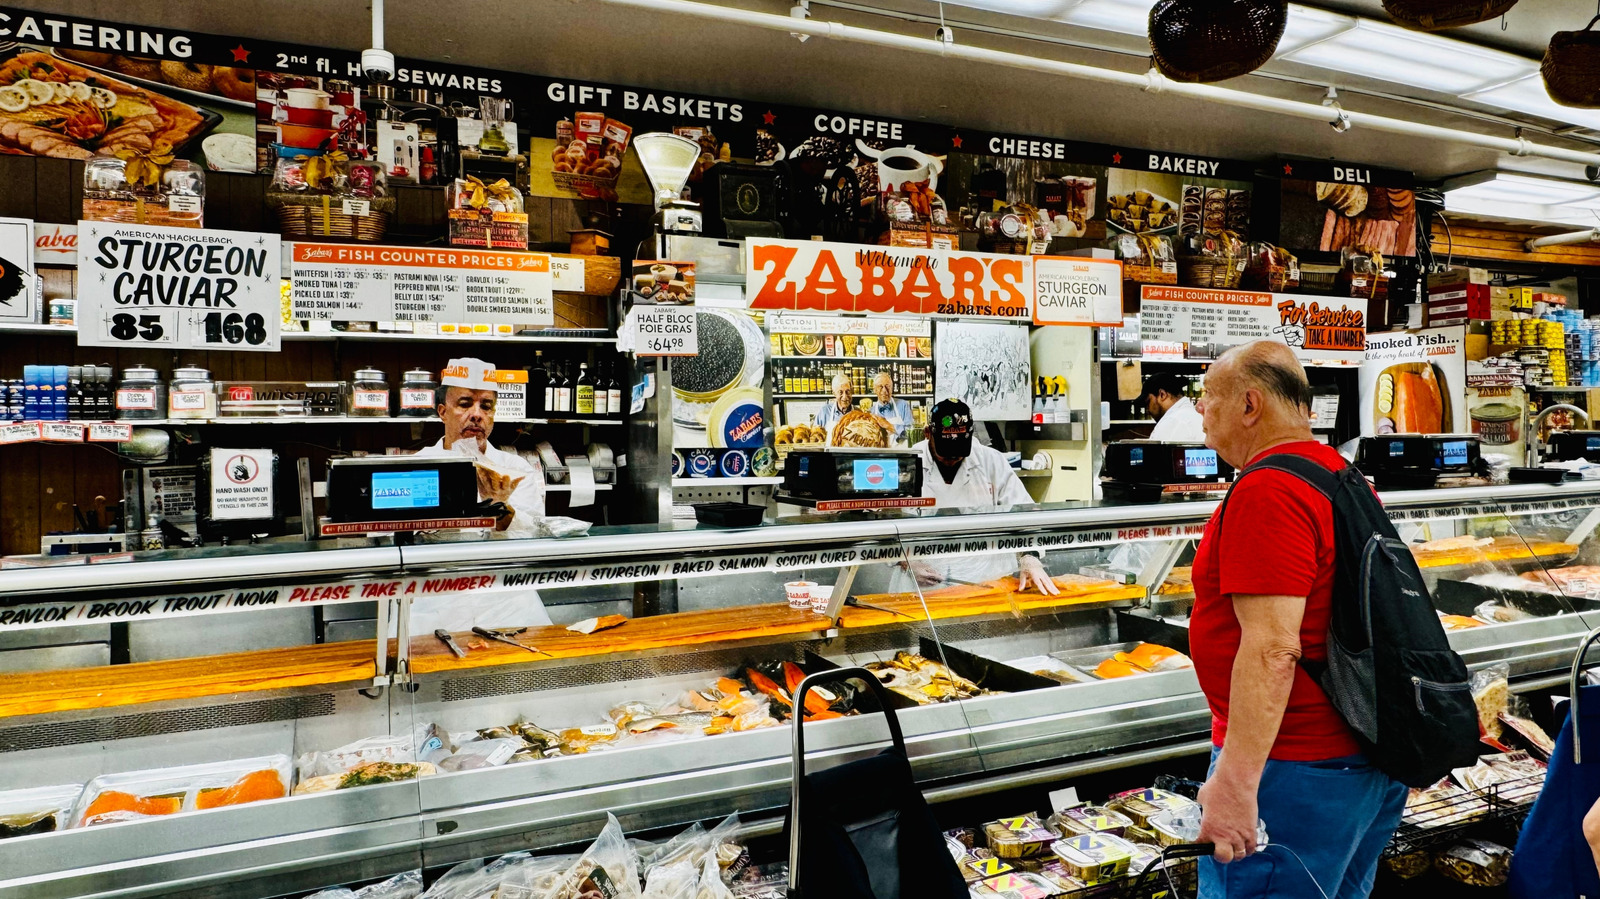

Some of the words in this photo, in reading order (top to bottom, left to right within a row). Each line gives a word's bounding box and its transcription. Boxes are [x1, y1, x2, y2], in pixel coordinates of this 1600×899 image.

[276, 53, 307, 70] 2nd
[316, 57, 337, 75] fl.
[347, 61, 503, 94] HSEWARES
[547, 82, 612, 107] GIFT
[623, 90, 743, 122] BASKETS
[814, 114, 903, 141] COFFEE
[989, 137, 1065, 159] CHEESE
[1148, 154, 1220, 176] BAKERY
[1333, 166, 1371, 183] DELI
[114, 229, 166, 241] AMERICAN
[170, 234, 233, 244] HACKLEBACK
[95, 236, 267, 278] STURGEON
[338, 249, 375, 261] FISH
[380, 251, 457, 265] COUNTER
[462, 255, 514, 267] PRICES
[858, 248, 921, 270] Welcome
[926, 253, 939, 269] to
[294, 270, 328, 278] WHITEFISH
[394, 273, 422, 281] PASTRAMI
[466, 276, 490, 284] GRAVLOX
[113, 271, 238, 308] CAVIAR
[294, 280, 320, 288] SMOKED
[394, 283, 424, 291] PEPPERED
[426, 284, 440, 292] NOVA
[485, 286, 502, 294] TROUT
[1038, 281, 1106, 296] STURGEON
[295, 290, 320, 298] PICKLED
[323, 290, 334, 298] LOX
[489, 296, 506, 304] CURED
[1164, 290, 1184, 299] FISH
[1186, 292, 1224, 302] COUNTER
[1226, 294, 1253, 303] PRICES
[295, 300, 314, 308] BAKED
[1039, 295, 1086, 308] CAVIAR
[512, 306, 532, 314] SALMON
[937, 301, 1029, 318] zabars.com
[1277, 299, 1308, 325] For
[1307, 301, 1364, 326] Service
[638, 314, 664, 323] HALF
[666, 314, 694, 324] BLOC
[640, 324, 662, 333] FOIE
[665, 325, 692, 333] GRAS
[1306, 326, 1323, 346] TAKE
[1324, 329, 1333, 346] A
[1334, 329, 1364, 348] NUMBER
[1365, 337, 1412, 350] Smoked
[1372, 352, 1381, 360] the
[1410, 510, 1430, 518] SABLE
[1434, 508, 1460, 516] SMOKED
[0, 604, 75, 625] RAVLOX
[86, 598, 159, 620] BROOK
[161, 593, 225, 614] TROUT
[234, 590, 278, 606] NOVA
[288, 584, 355, 602] PLEASE
[360, 582, 401, 598] TAKE
[404, 581, 416, 595] A
[421, 575, 496, 594] NUMBER!
[502, 570, 578, 588] WHITEFISH
[590, 564, 660, 581] STURGEON
[672, 560, 714, 575] BAKED
[718, 556, 769, 571] SALMON
[776, 553, 816, 567] SCOTCH
[820, 550, 856, 564] CURED
[860, 547, 902, 561] SALMON
[913, 543, 961, 556] PASTRAMI
[964, 541, 988, 552] NOVA
[998, 537, 1033, 550] DOUBLE
[1036, 534, 1074, 547] SMOKED
[1077, 531, 1112, 544] SALMON
[1117, 528, 1150, 540] PLEASE
[1153, 526, 1172, 538] TAKE
[1175, 526, 1181, 536] A
